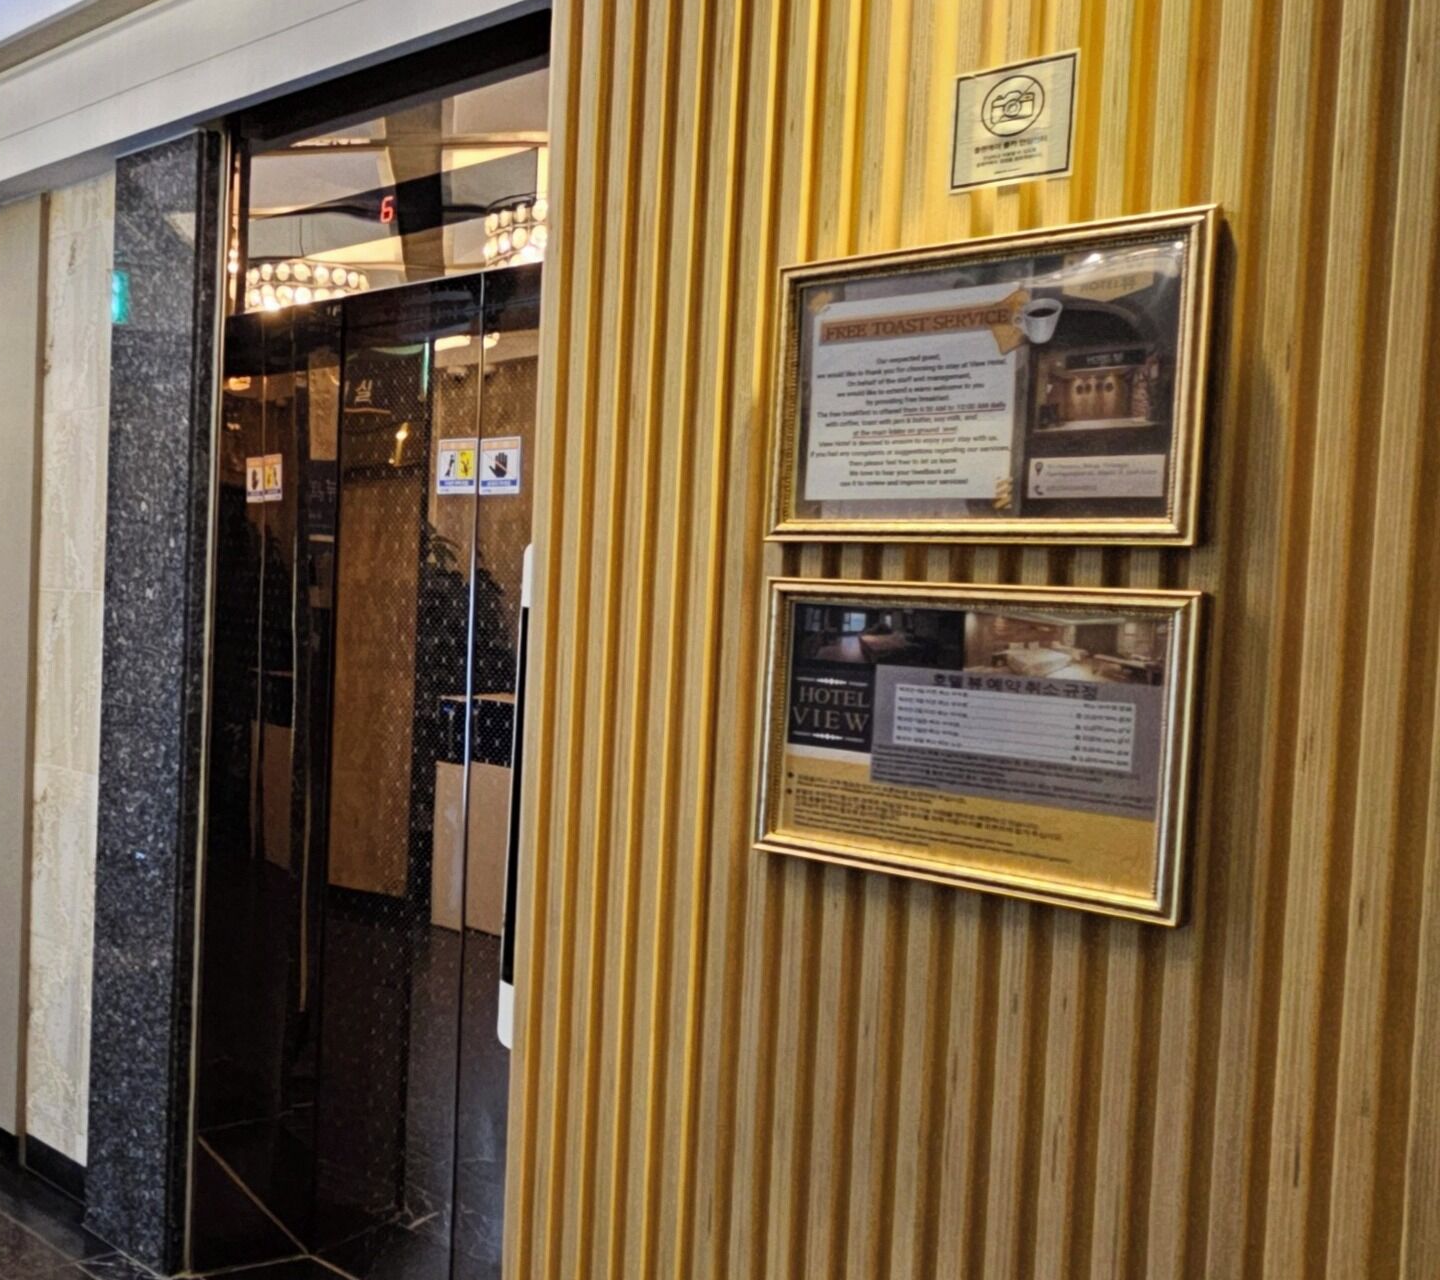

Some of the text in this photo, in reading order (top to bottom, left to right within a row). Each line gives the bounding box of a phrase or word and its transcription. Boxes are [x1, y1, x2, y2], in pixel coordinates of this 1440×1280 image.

[380, 195, 394, 224] 6
[826, 308, 1009, 340] FREE TOAST SERVICE
[798, 685, 871, 708] HOTEL
[792, 706, 871, 732] VIEW
